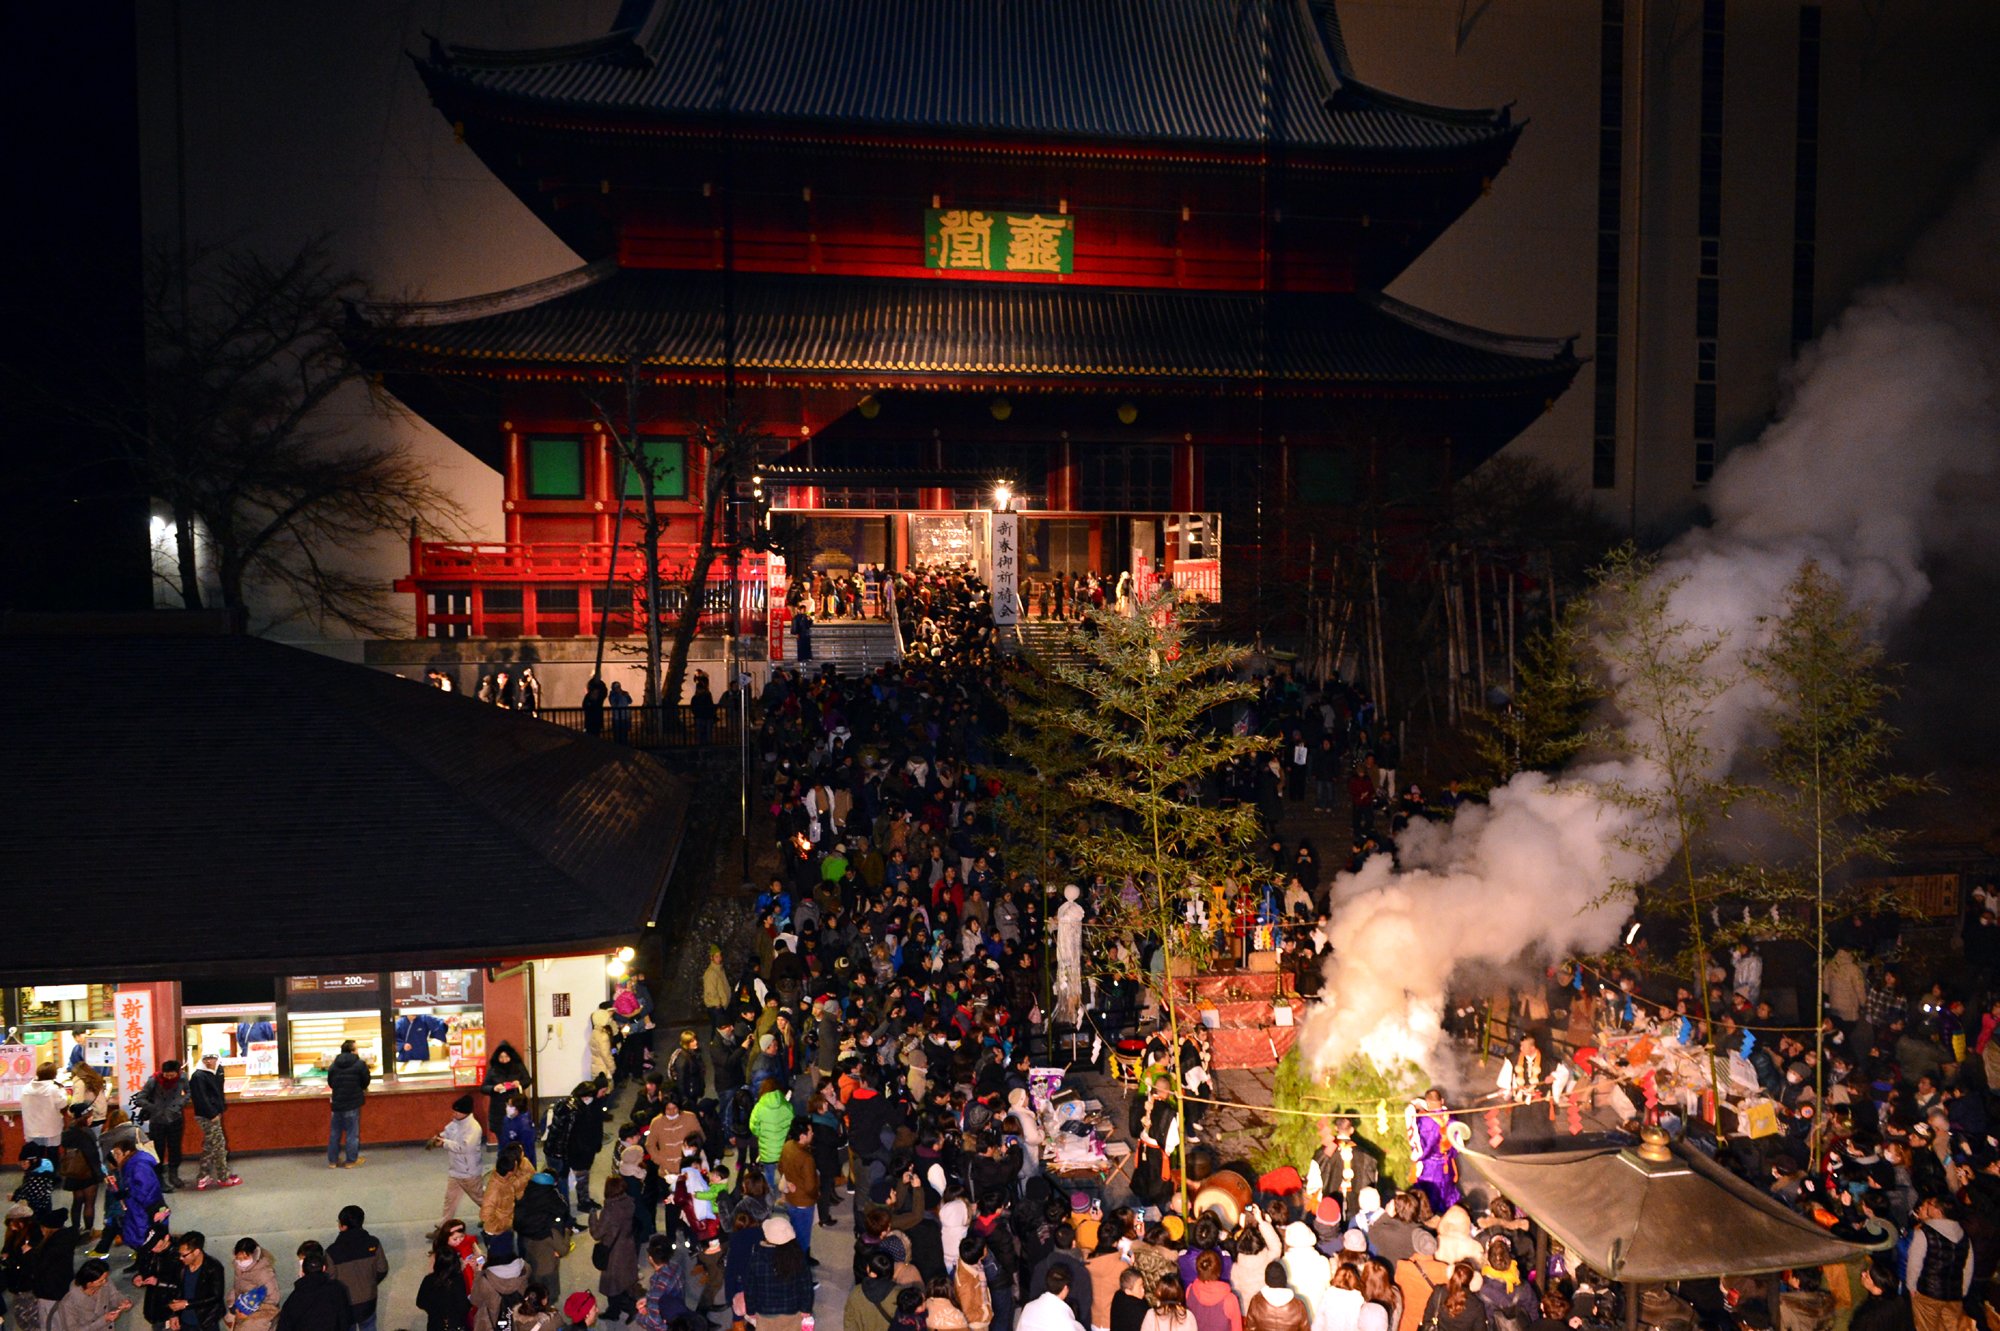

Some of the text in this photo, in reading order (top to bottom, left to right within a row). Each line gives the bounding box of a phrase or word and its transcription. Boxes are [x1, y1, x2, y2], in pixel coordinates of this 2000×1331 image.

[996, 520, 1015, 618] 新春御祈祷会
